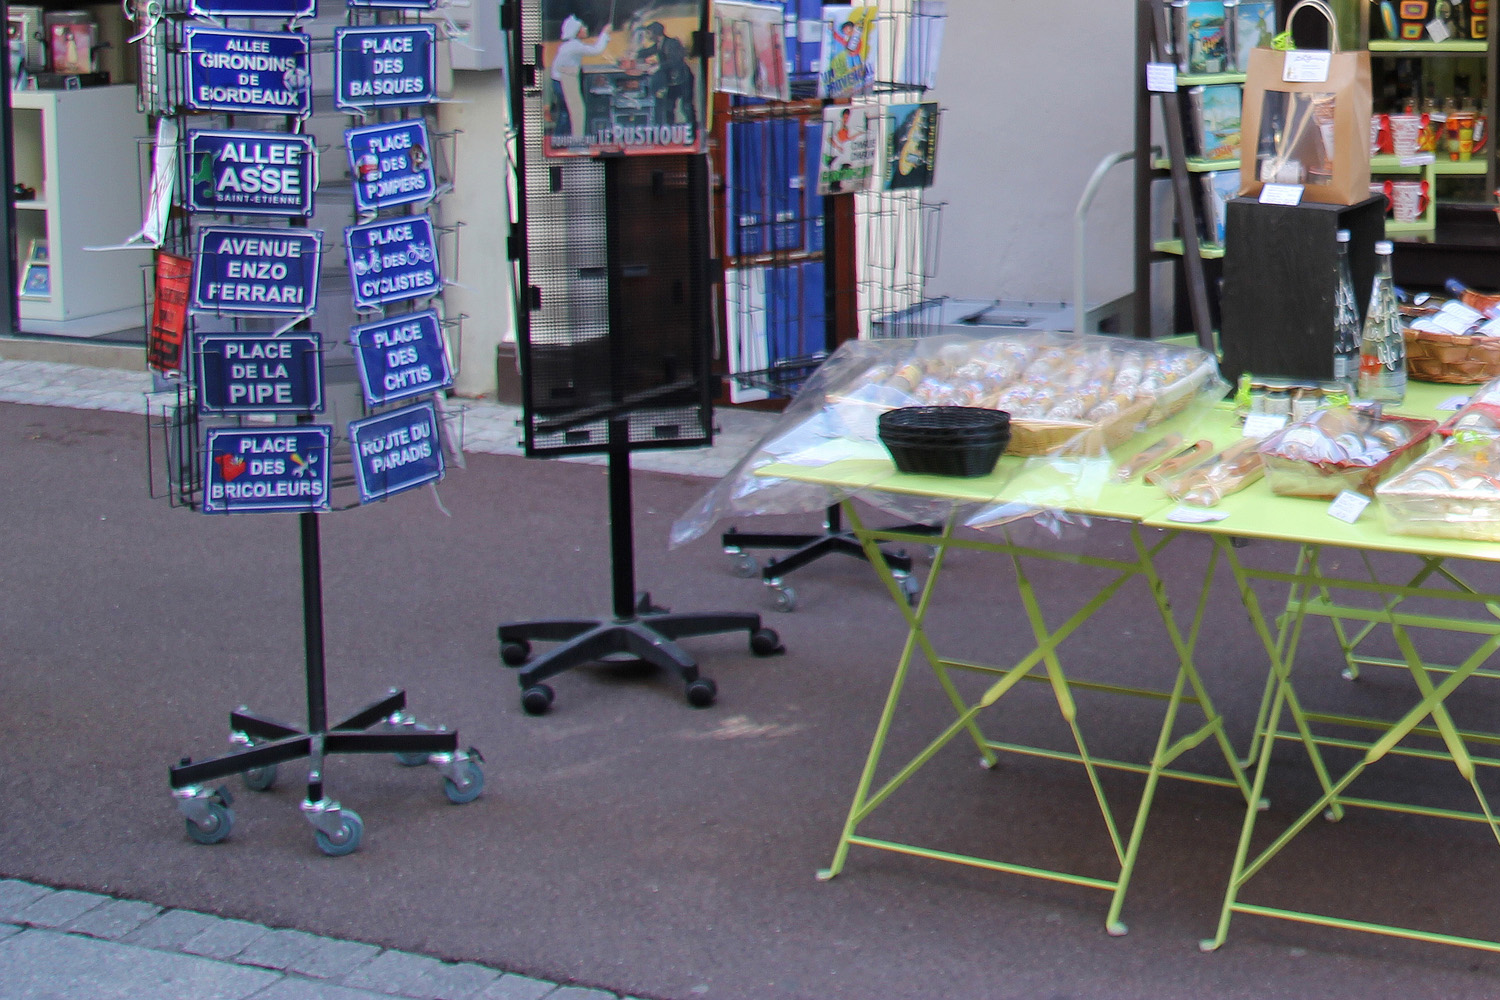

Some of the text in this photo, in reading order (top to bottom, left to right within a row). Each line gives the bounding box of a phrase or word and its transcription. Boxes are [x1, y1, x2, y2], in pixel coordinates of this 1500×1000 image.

[226, 38, 270, 53] ALLEE
[362, 38, 413, 54] PLACE
[199, 52, 297, 72] GIRONDINS
[372, 59, 404, 75] DES
[238, 73, 259, 86] DE
[351, 77, 423, 96] BASQUES
[199, 85, 299, 106] BORDEAUX
[368, 132, 412, 154] PLACE
[220, 142, 301, 165] ALLEE
[381, 155, 407, 172] DES
[217, 166, 301, 195] ASSE
[366, 173, 427, 199] POMPIERS
[216, 194, 301, 205] SAINT-ETIENNE
[368, 226, 414, 243] PLACE
[218, 239, 300, 258] AVENUE
[383, 253, 407, 268] DES
[228, 262, 287, 280] ENZO
[208, 283, 303, 304] FERRARI
[361, 271, 434, 298] CYCLISTES
[374, 323, 422, 350] PLACE
[225, 344, 292, 360] PLACE
[389, 347, 418, 366] DES
[232, 364, 288, 379] DE LA
[384, 367, 432, 392] CH'TIS
[229, 383, 293, 404] PIPE
[240, 437, 297, 453] PLACE
[361, 422, 431, 456] ROUTE DU
[250, 459, 286, 475] DES
[371, 447, 432, 474] PARADIS
[211, 480, 323, 499] BRICOLEURS
